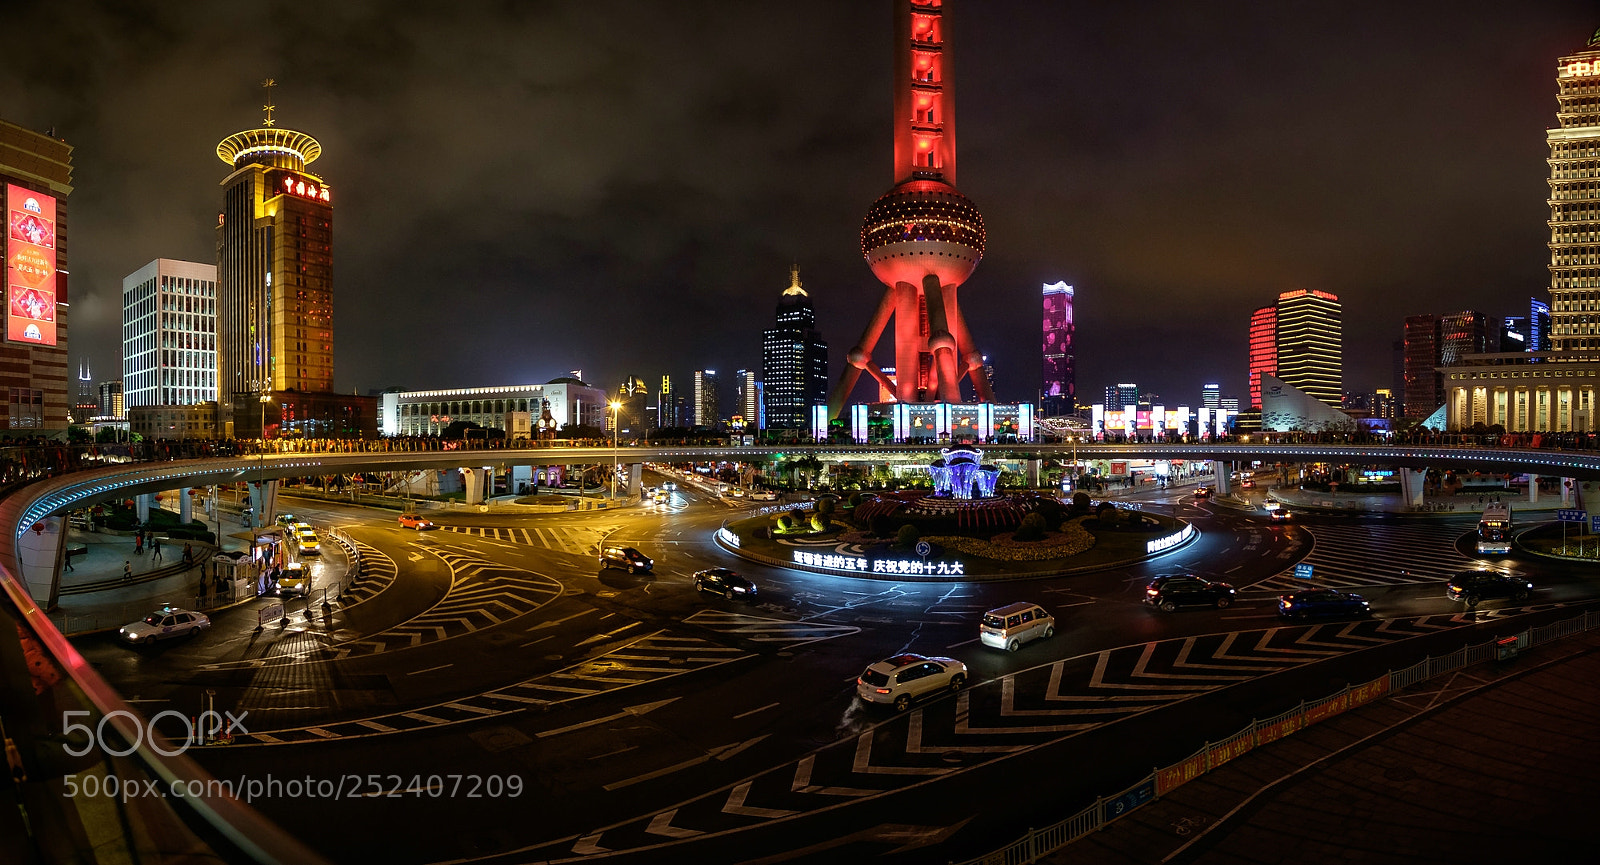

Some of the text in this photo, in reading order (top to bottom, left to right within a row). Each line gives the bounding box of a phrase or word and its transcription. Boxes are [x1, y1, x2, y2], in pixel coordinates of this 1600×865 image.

[1567, 61, 1600, 76] 中
[873, 559, 964, 574] 庆祝党的十九大
